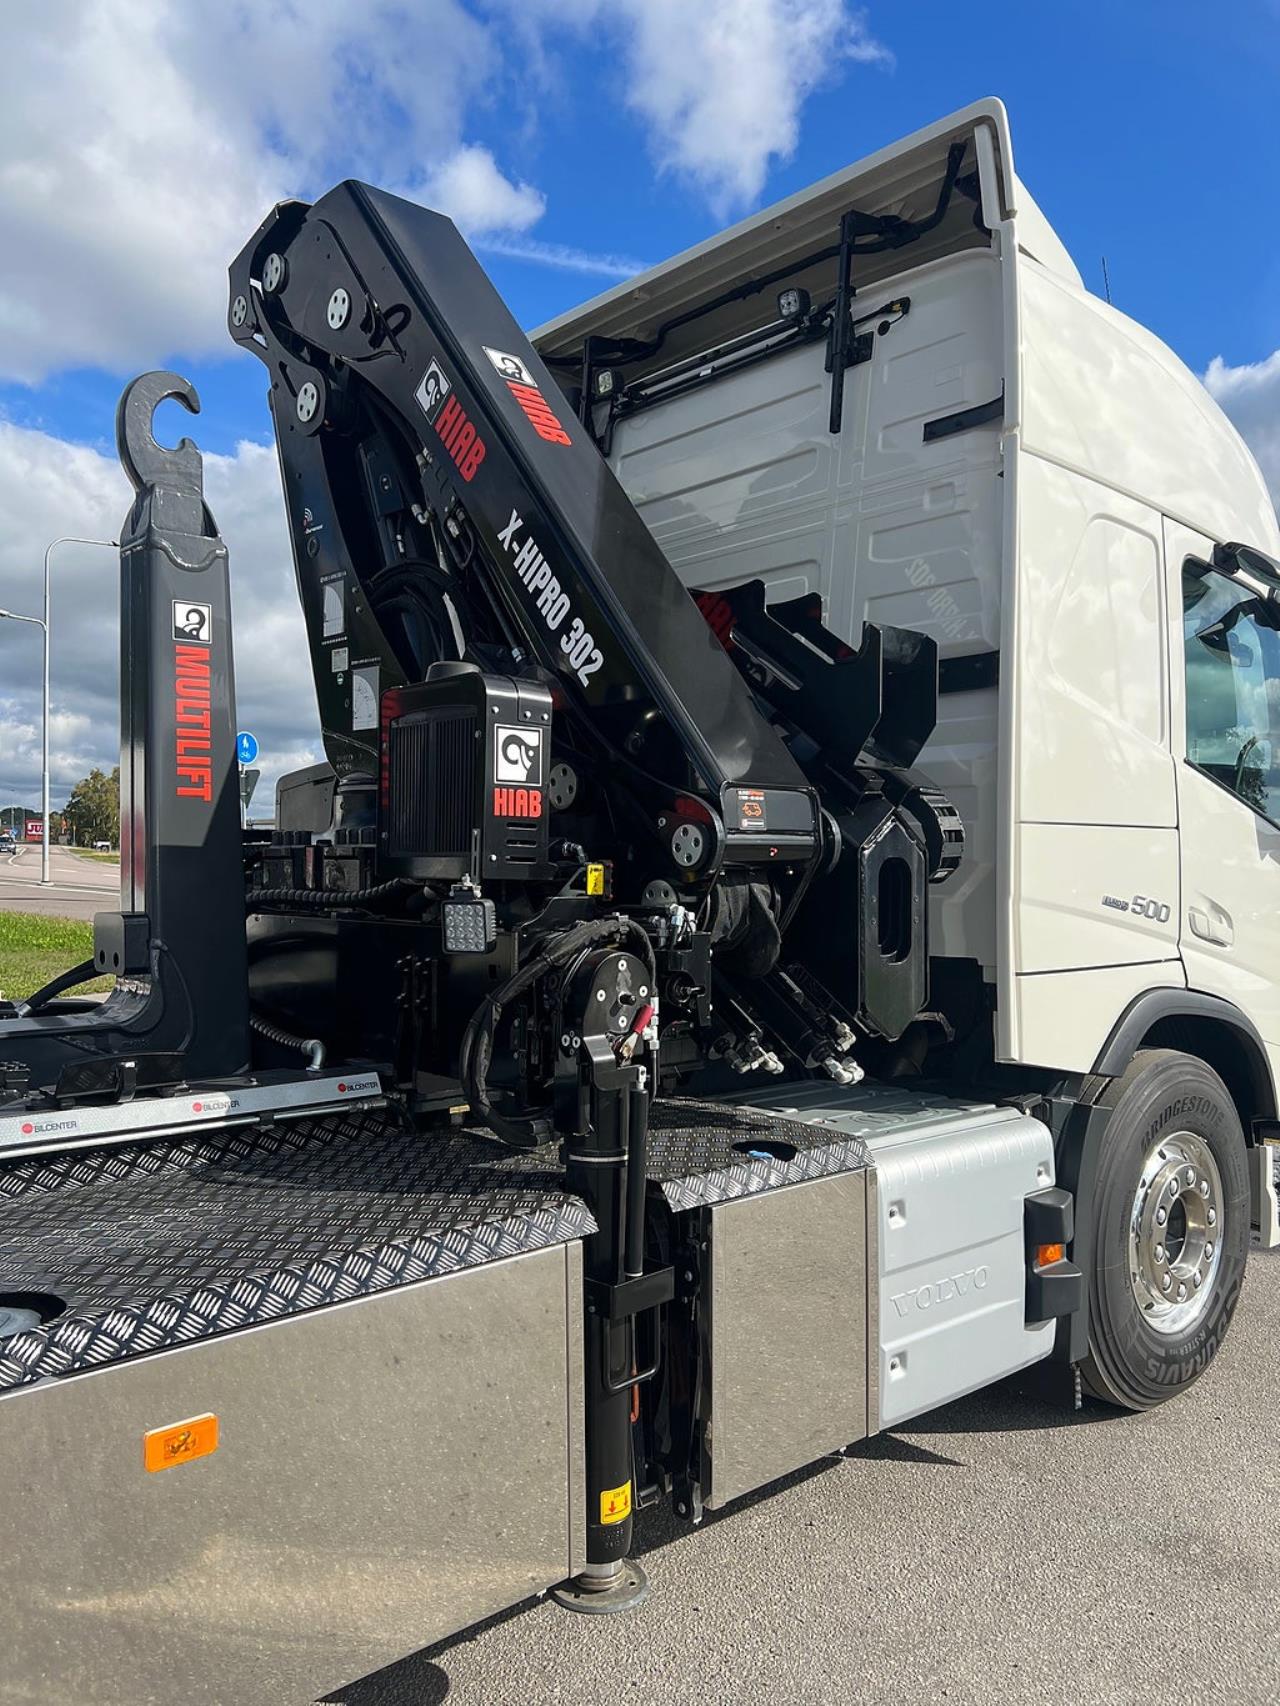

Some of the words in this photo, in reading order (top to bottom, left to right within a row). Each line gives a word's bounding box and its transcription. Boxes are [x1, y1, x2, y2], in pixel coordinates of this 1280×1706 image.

[434, 393, 486, 482] HIAB
[506, 380, 572, 446] HIAB
[497, 508, 571, 631] X-HIPRO
[560, 617, 604, 688] 302
[175, 645, 212, 802] MULTILIFT
[494, 787, 542, 818] HIAB
[1130, 895, 1171, 923] 500
[203, 1099, 241, 1112] BILCENTER
[346, 1081, 378, 1092] BILCENTER
[34, 1120, 77, 1133] BILCENTER
[1140, 1095, 1225, 1150] BRIDGESTONE
[889, 1264, 990, 1318] VOLVO
